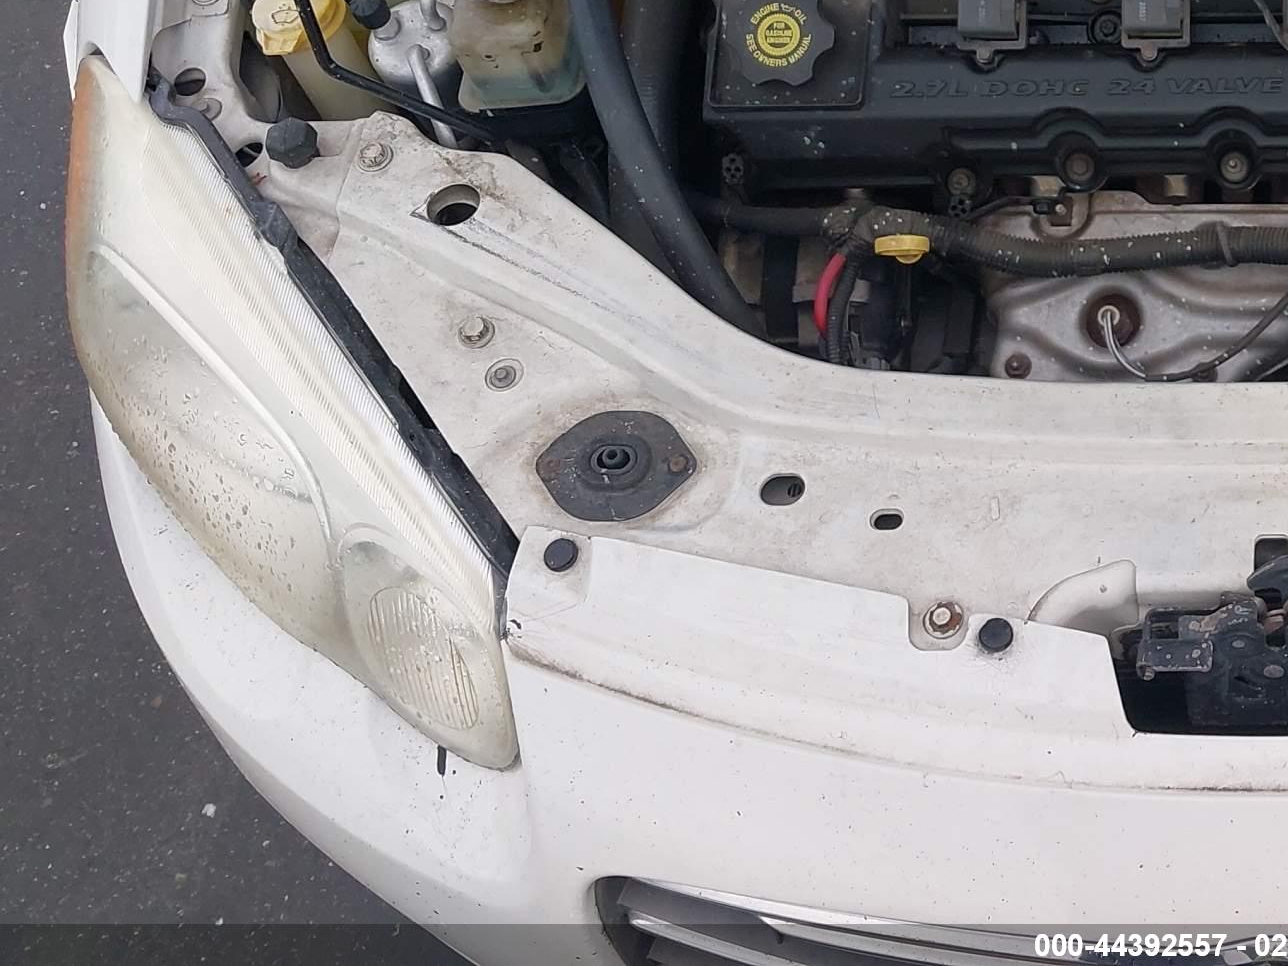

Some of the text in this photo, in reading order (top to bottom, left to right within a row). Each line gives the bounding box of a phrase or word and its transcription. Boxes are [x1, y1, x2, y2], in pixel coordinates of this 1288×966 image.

[750, 2, 808, 25] ENGINE OIL
[745, 33, 758, 52] SEE
[788, 33, 812, 64] MANUAL
[888, 76, 1286, 99] 2.7L DOHC 24 VALVE
